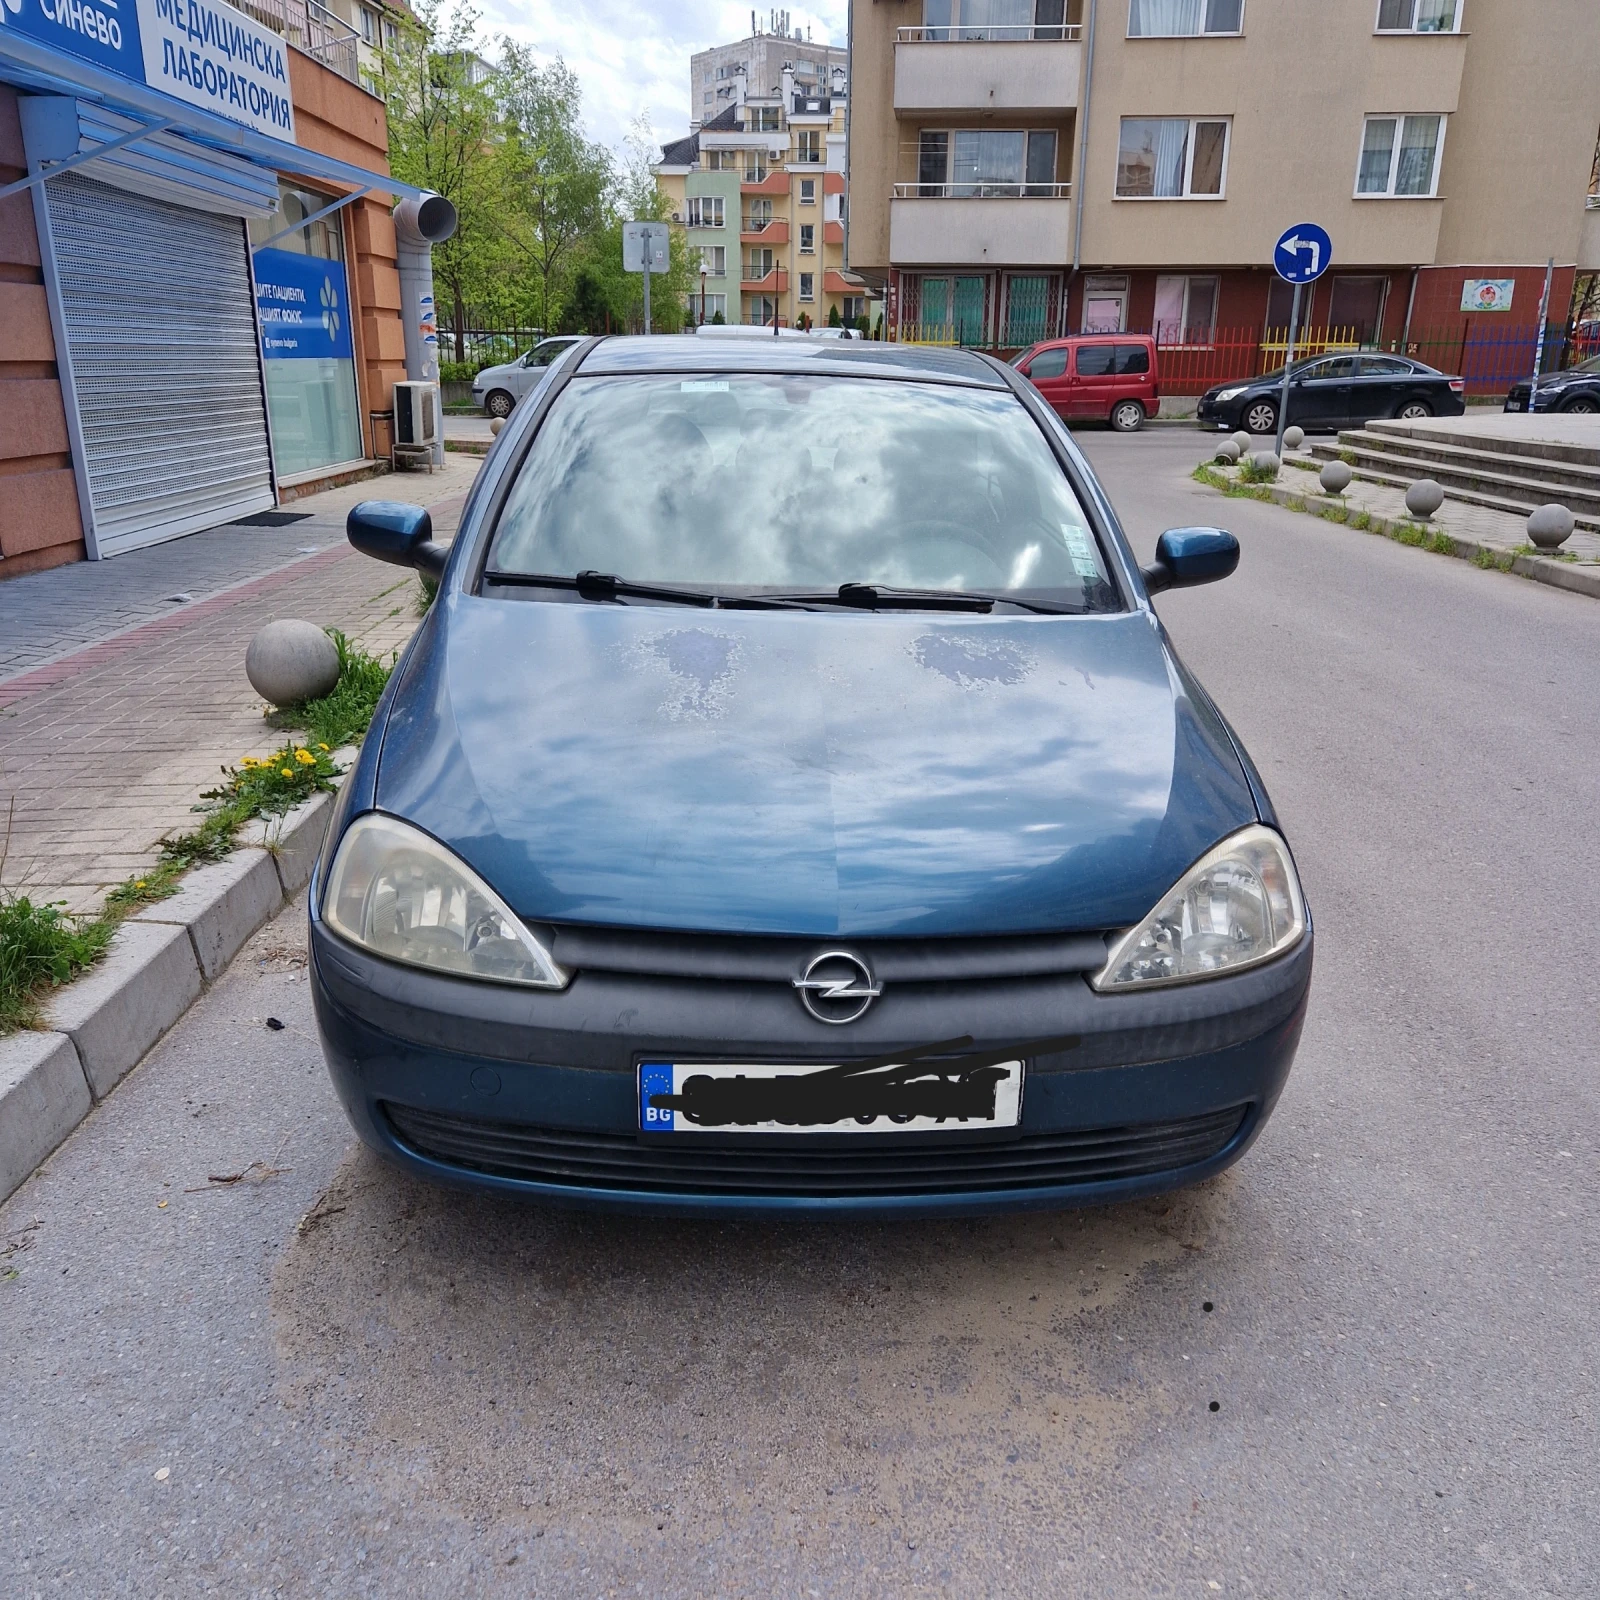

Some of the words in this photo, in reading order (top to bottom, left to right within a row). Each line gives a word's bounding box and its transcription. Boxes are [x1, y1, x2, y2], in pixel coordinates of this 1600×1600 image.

[156, 0, 286, 84] МЕДИЦИНСКА
[163, 37, 291, 131] ЛАБОРАТОРИЯ
[281, 308, 303, 324] ФОКУС
[646, 1107, 671, 1122] BG
